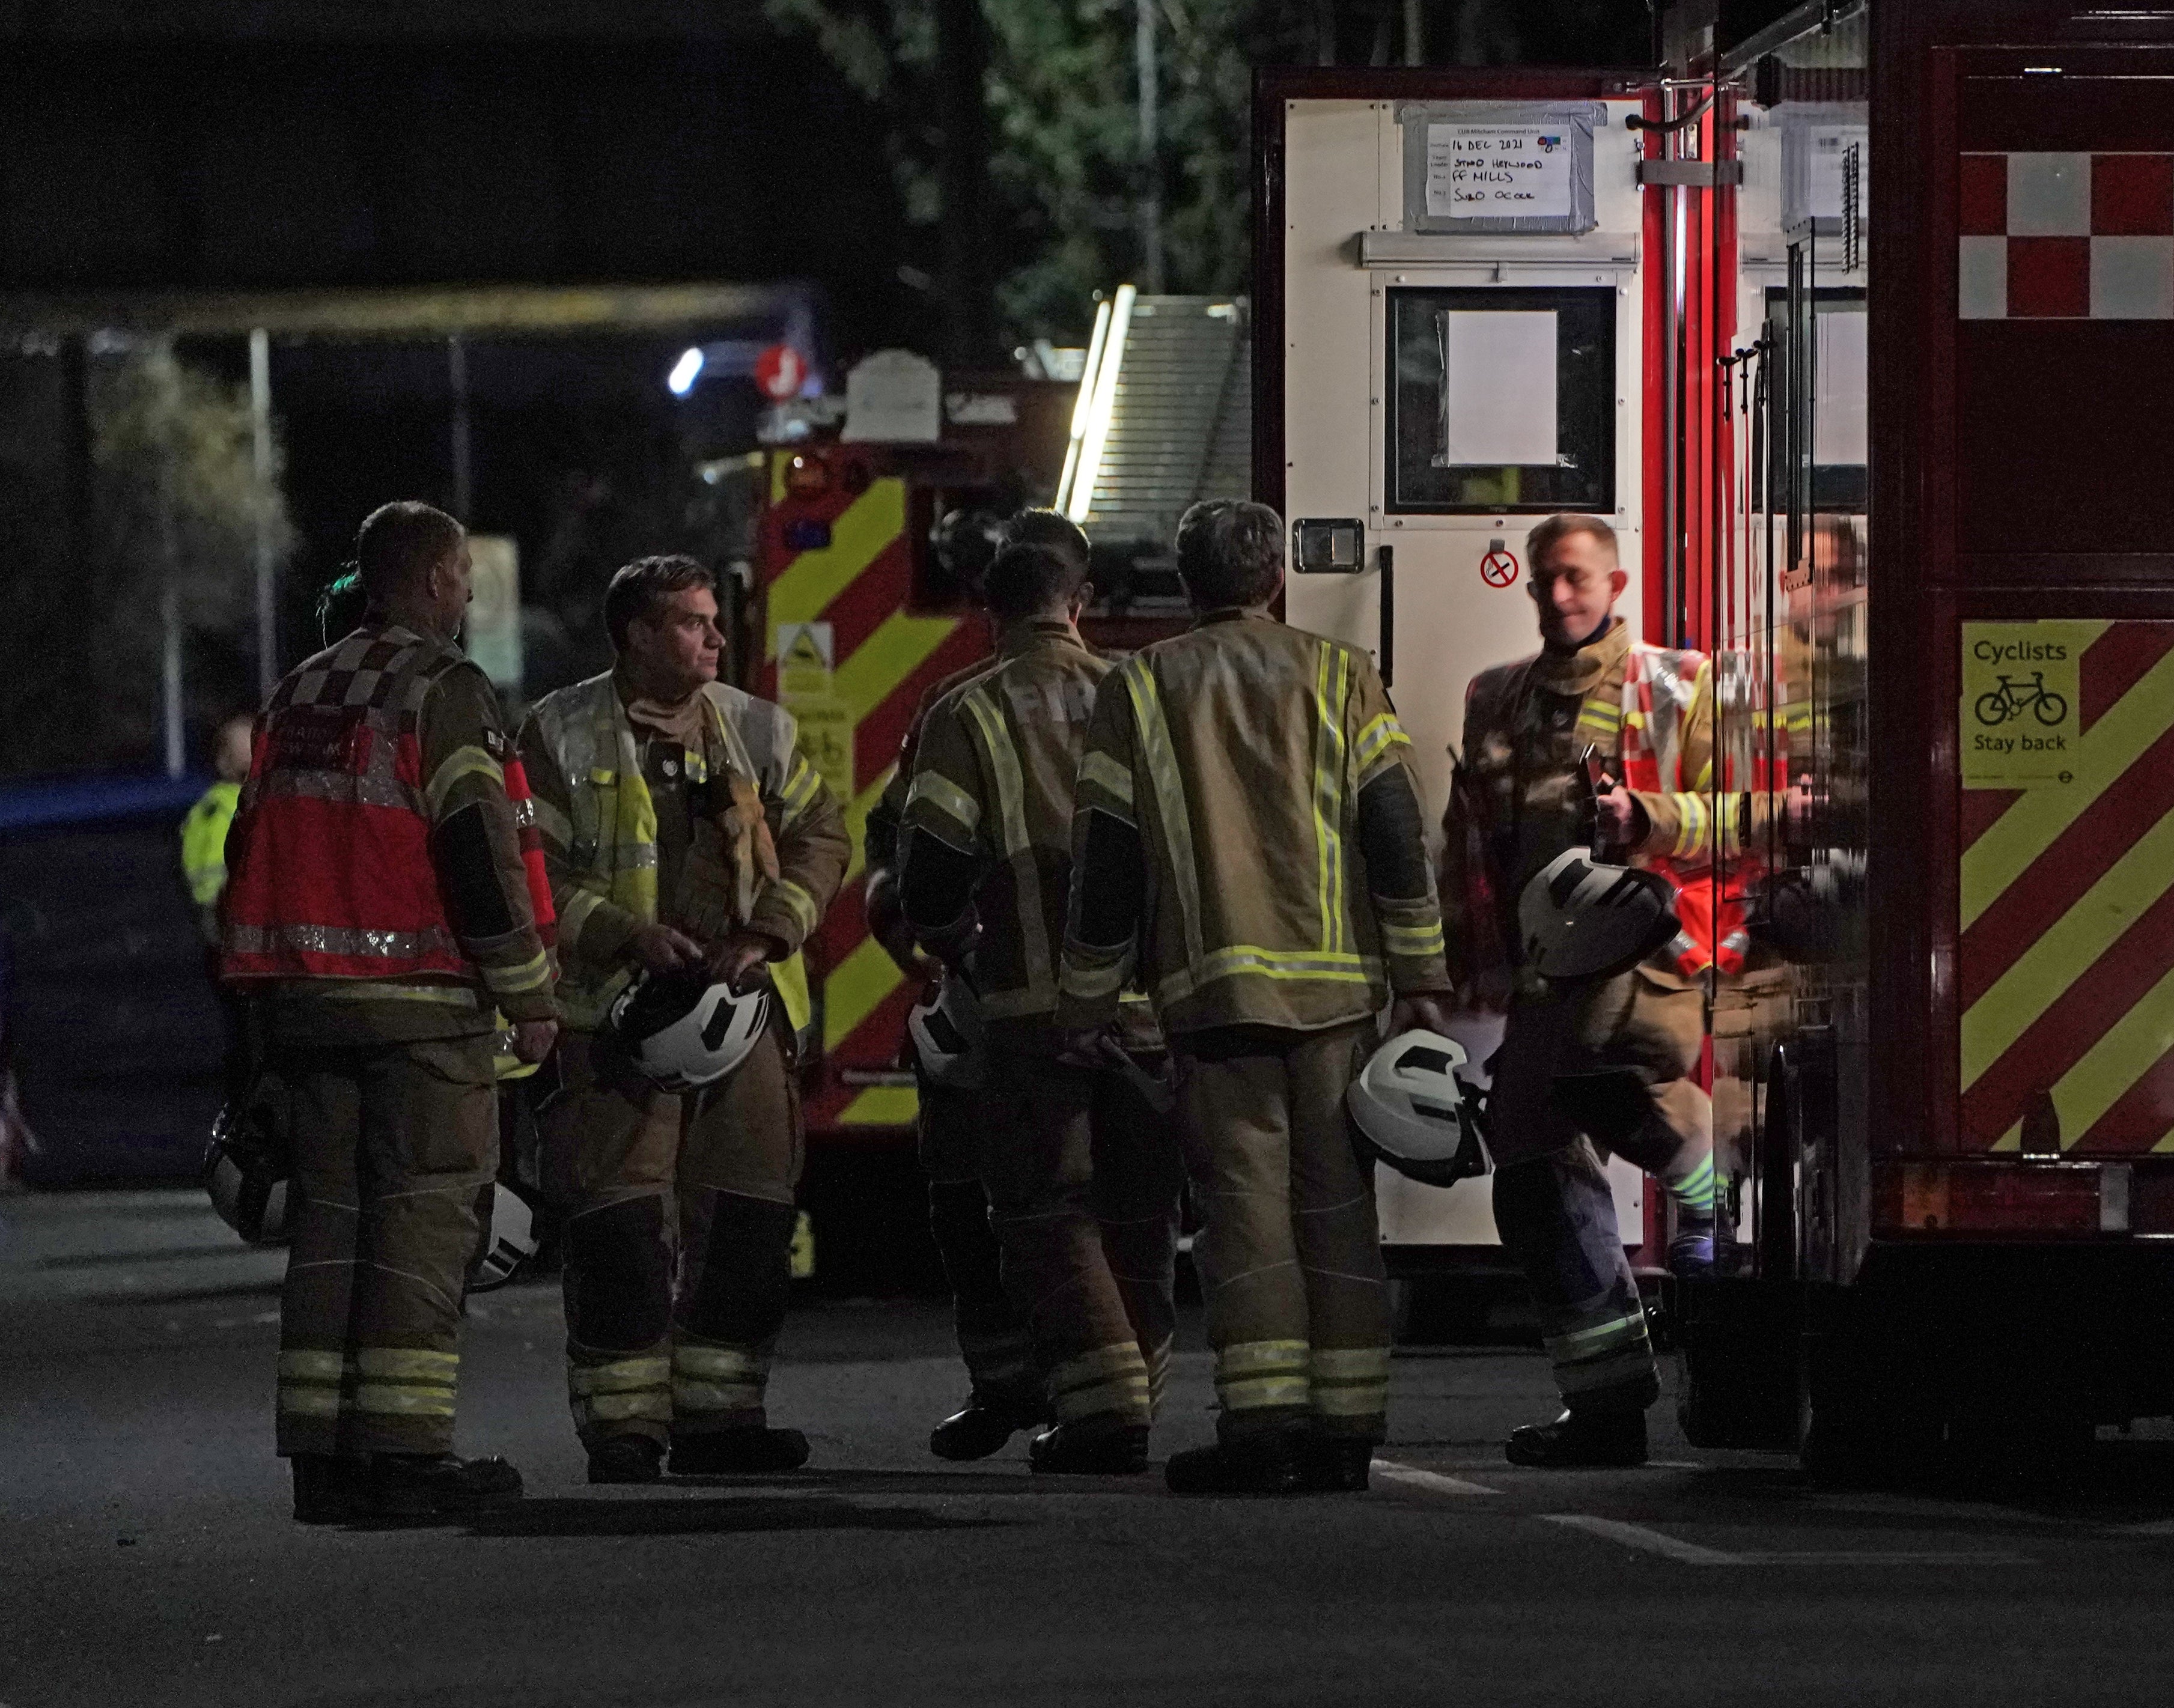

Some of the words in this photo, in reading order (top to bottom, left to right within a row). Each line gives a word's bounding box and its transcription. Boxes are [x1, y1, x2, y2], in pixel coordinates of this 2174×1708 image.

[1453, 140, 1462, 151] 16
[1469, 141, 1491, 151] DEC
[1499, 139, 1522, 150] 2021
[1473, 171, 1513, 183] MILLS
[1974, 640, 2068, 665] Cyclists
[1975, 735, 2014, 755] Stay
[2022, 735, 2066, 751] back
